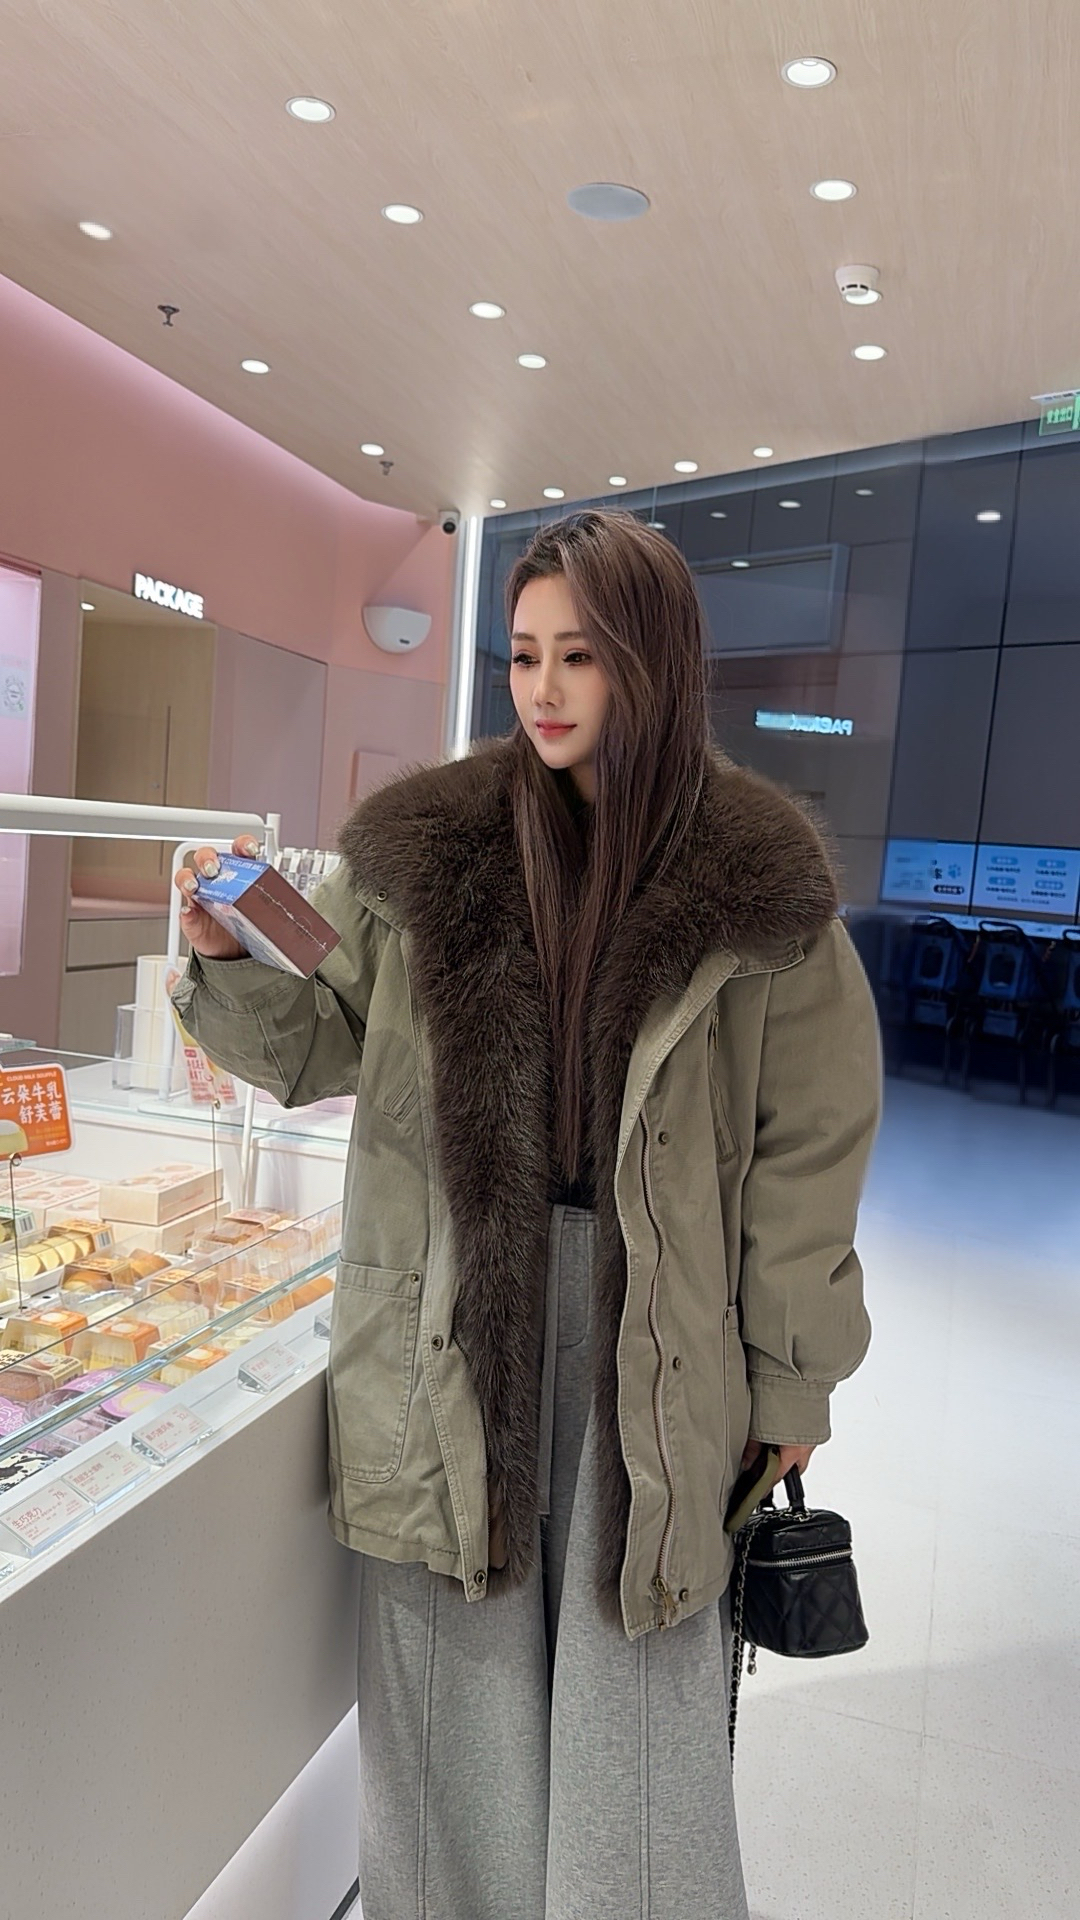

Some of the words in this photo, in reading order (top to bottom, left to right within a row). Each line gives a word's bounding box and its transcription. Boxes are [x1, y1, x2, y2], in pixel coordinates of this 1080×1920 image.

[134, 572, 204, 619] PACKAGE
[1, 1081, 62, 1105] 云朵牛乳
[18, 1100, 63, 1124] 舒芙蕾
[52, 1491, 65, 1500] 79
[12, 1507, 42, 1529] 生巧克力
